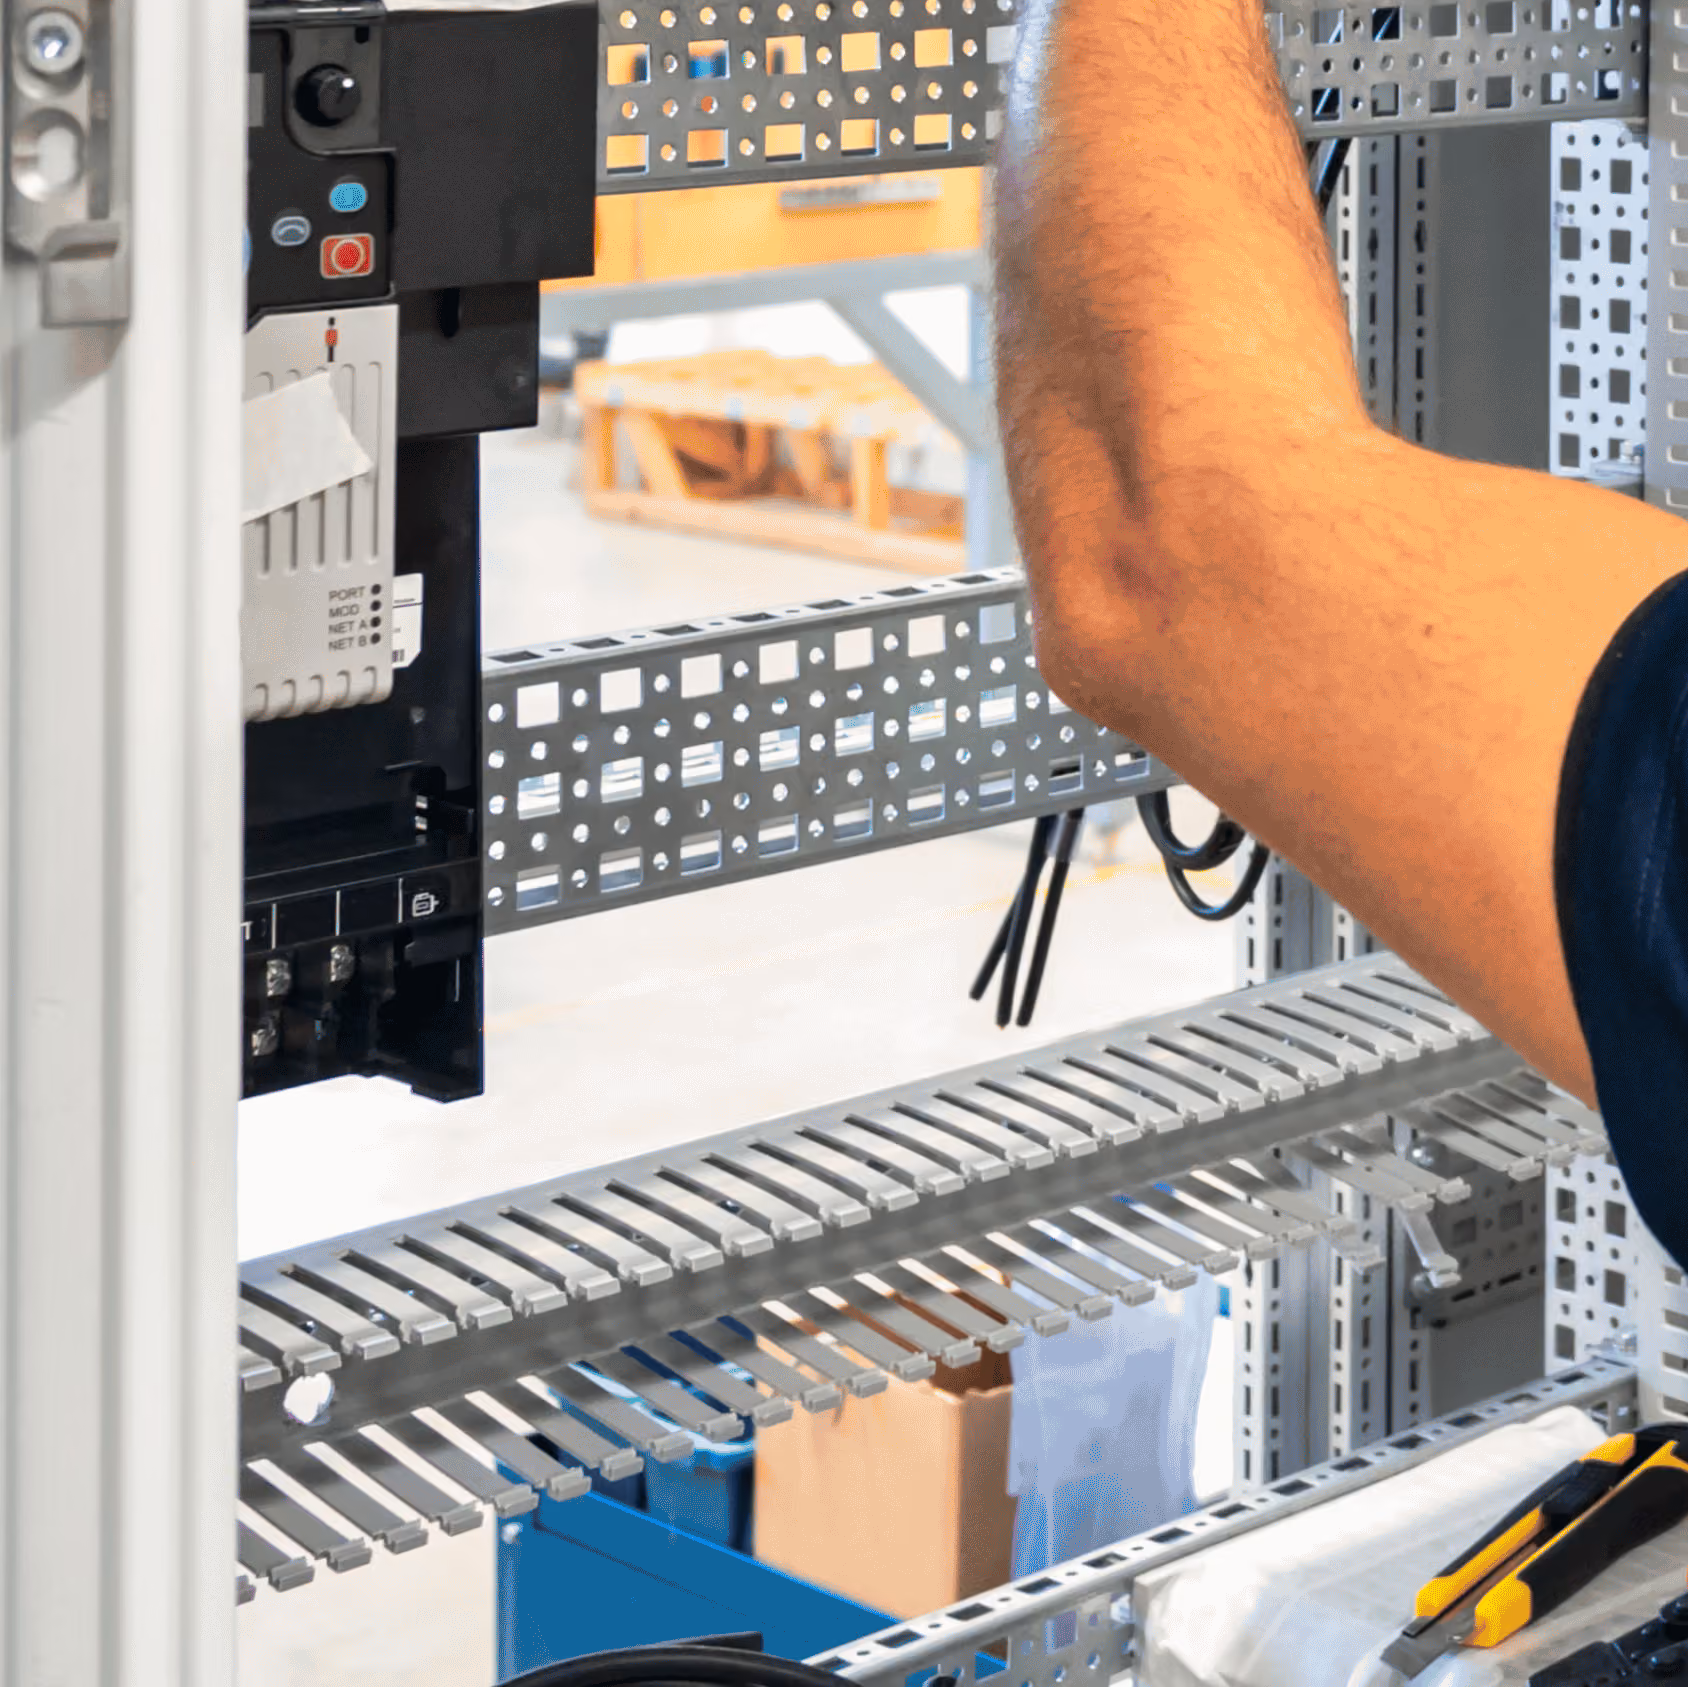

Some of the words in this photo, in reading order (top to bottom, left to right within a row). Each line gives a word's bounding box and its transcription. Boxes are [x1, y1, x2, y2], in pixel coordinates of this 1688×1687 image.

[328, 586, 366, 602] PORT
[328, 604, 360, 618] MOD
[328, 620, 355, 635] NET
[359, 619, 368, 630] A
[328, 637, 354, 651] NET
[358, 634, 367, 648] B
